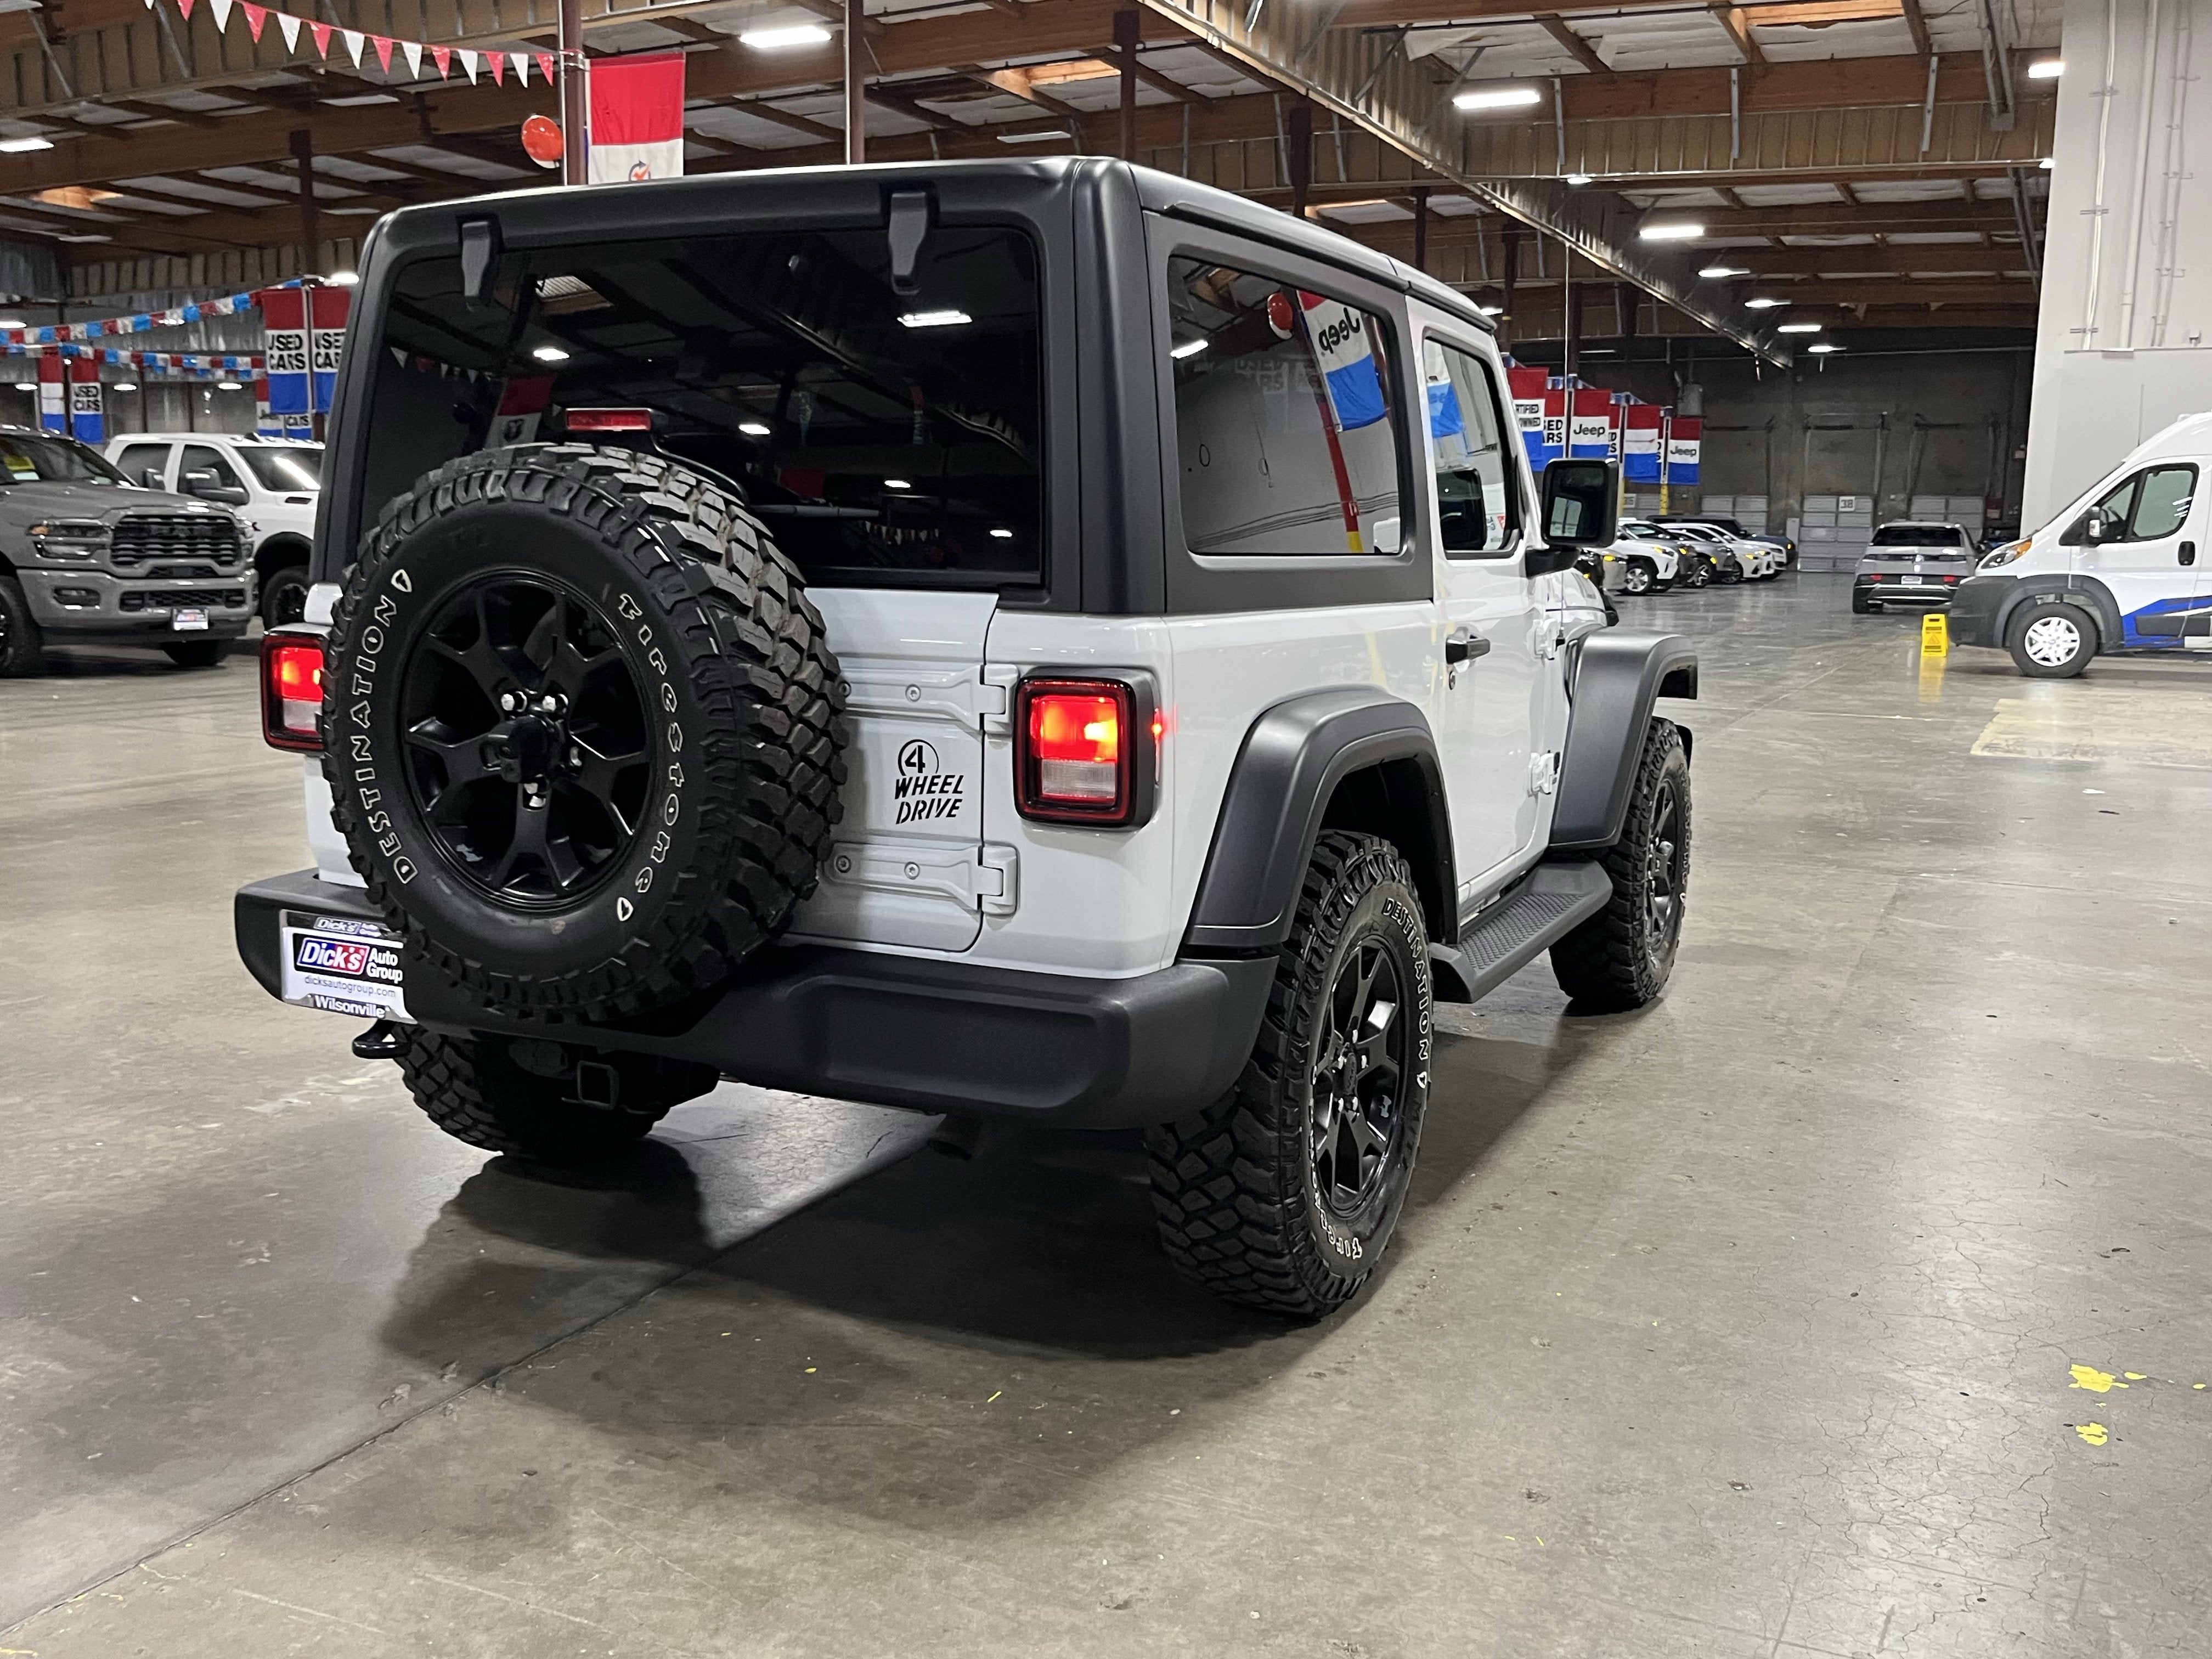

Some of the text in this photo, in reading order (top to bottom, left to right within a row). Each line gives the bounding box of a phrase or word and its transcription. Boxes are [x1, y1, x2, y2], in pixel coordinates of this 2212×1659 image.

[314, 332, 345, 349] USE
[1573, 424, 1606, 437] Jeep
[1670, 445, 1697, 457] Jeep
[1840, 499, 1853, 509] 38
[349, 595, 419, 884] DESTINATION
[904, 745, 926, 774] 4
[895, 775, 964, 800] WHEEL
[895, 798, 963, 825] DRIVE
[302, 942, 364, 970] Dick's
[369, 947, 399, 966] Auto
[366, 962, 403, 984] Group
[1383, 898, 1430, 1060] DESTINATION
[304, 975, 396, 997] dicksautogroup.com
[314, 995, 386, 1018] Wilsonville
